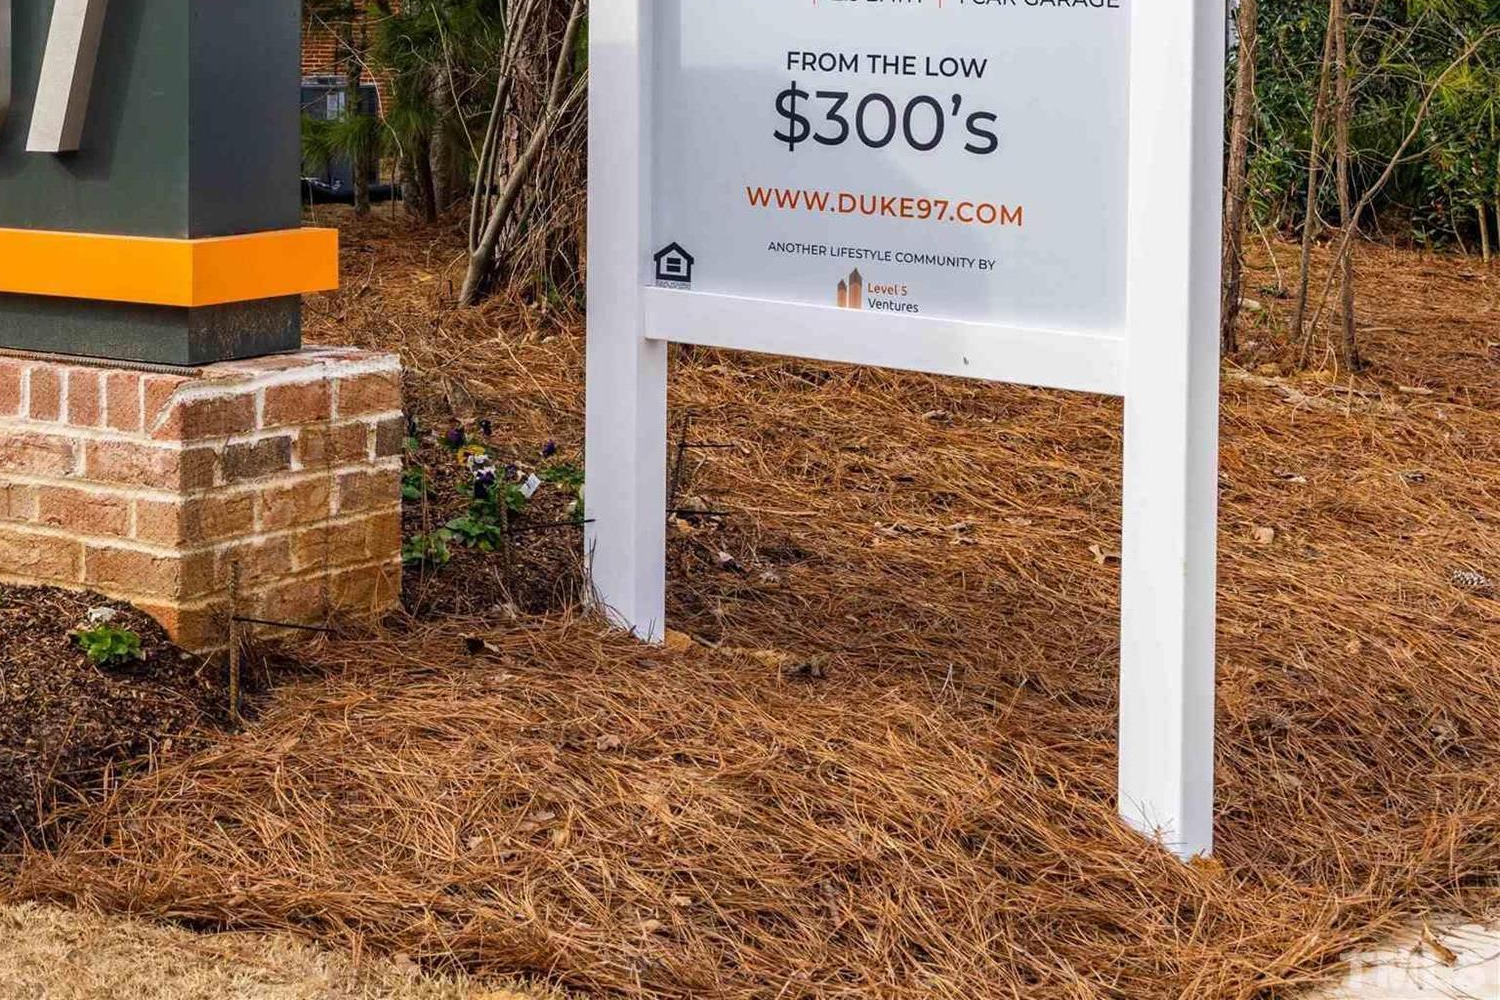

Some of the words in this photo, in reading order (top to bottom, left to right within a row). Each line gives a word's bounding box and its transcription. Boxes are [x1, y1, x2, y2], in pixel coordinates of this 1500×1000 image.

[788, 52, 858, 72] FROM
[867, 55, 916, 75] THE
[926, 57, 987, 78] LOW
[747, 187, 1022, 226] WWW.DUKE97.COM
[768, 242, 826, 255] ANOTHER
[831, 247, 891, 261] LIFESTYLE
[895, 252, 975, 268] COMMUNITY
[979, 259, 995, 270] BY
[868, 283, 897, 296] Level
[901, 285, 908, 297] 5
[868, 298, 918, 313] Ventures
